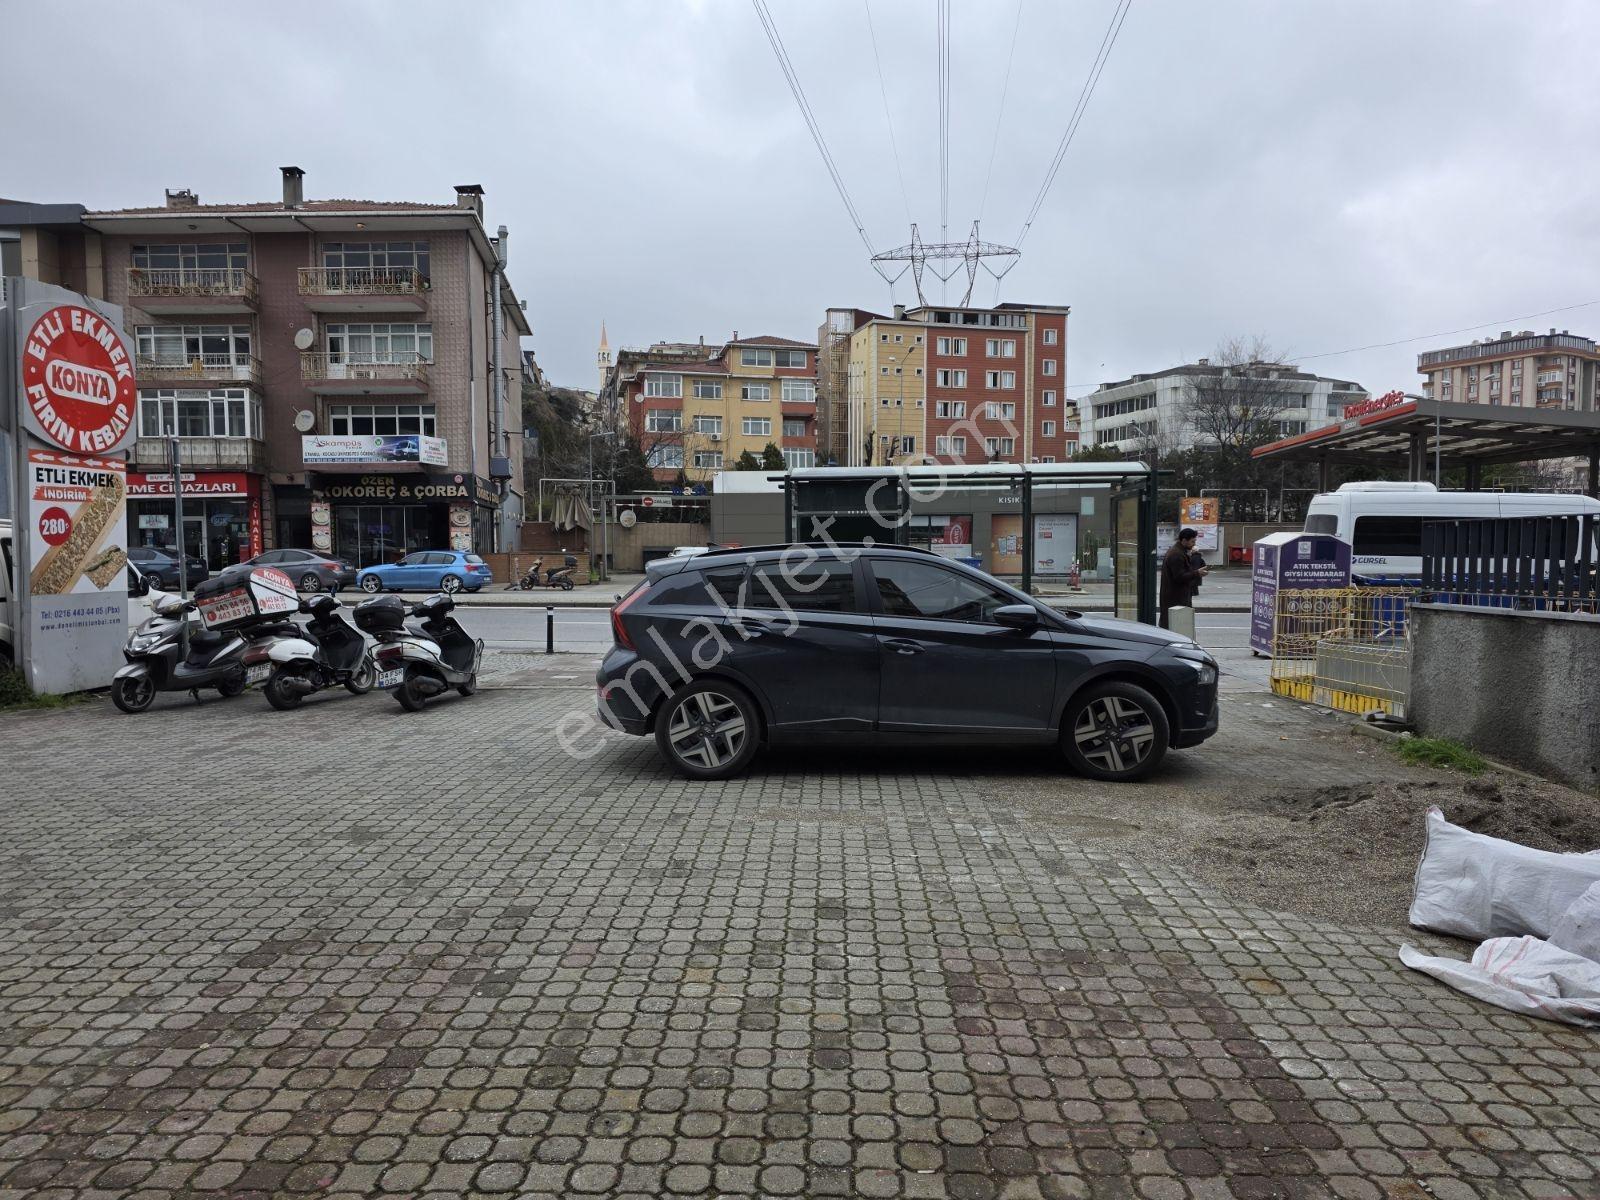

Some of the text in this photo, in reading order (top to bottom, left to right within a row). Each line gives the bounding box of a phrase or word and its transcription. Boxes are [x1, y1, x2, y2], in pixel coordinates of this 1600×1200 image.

[71, 309, 132, 381] EKMEK
[52, 364, 111, 400] KONYA
[28, 383, 129, 451] FIRIN KEBAP
[69, 470, 114, 488] EKMEK
[361, 475, 394, 485] ÖZEN
[43, 487, 87, 500] İNDİRİM
[323, 486, 396, 499] KOKOREÇ
[400, 486, 411, 497] &
[414, 485, 468, 499] ÇORBA
[263, 569, 292, 588] KONYA
[54, 609, 71, 618] 0216
[73, 608, 84, 617] 443
[86, 607, 94, 615] 44
[95, 606, 103, 615] 05
[385, 676, 398, 685] 025
